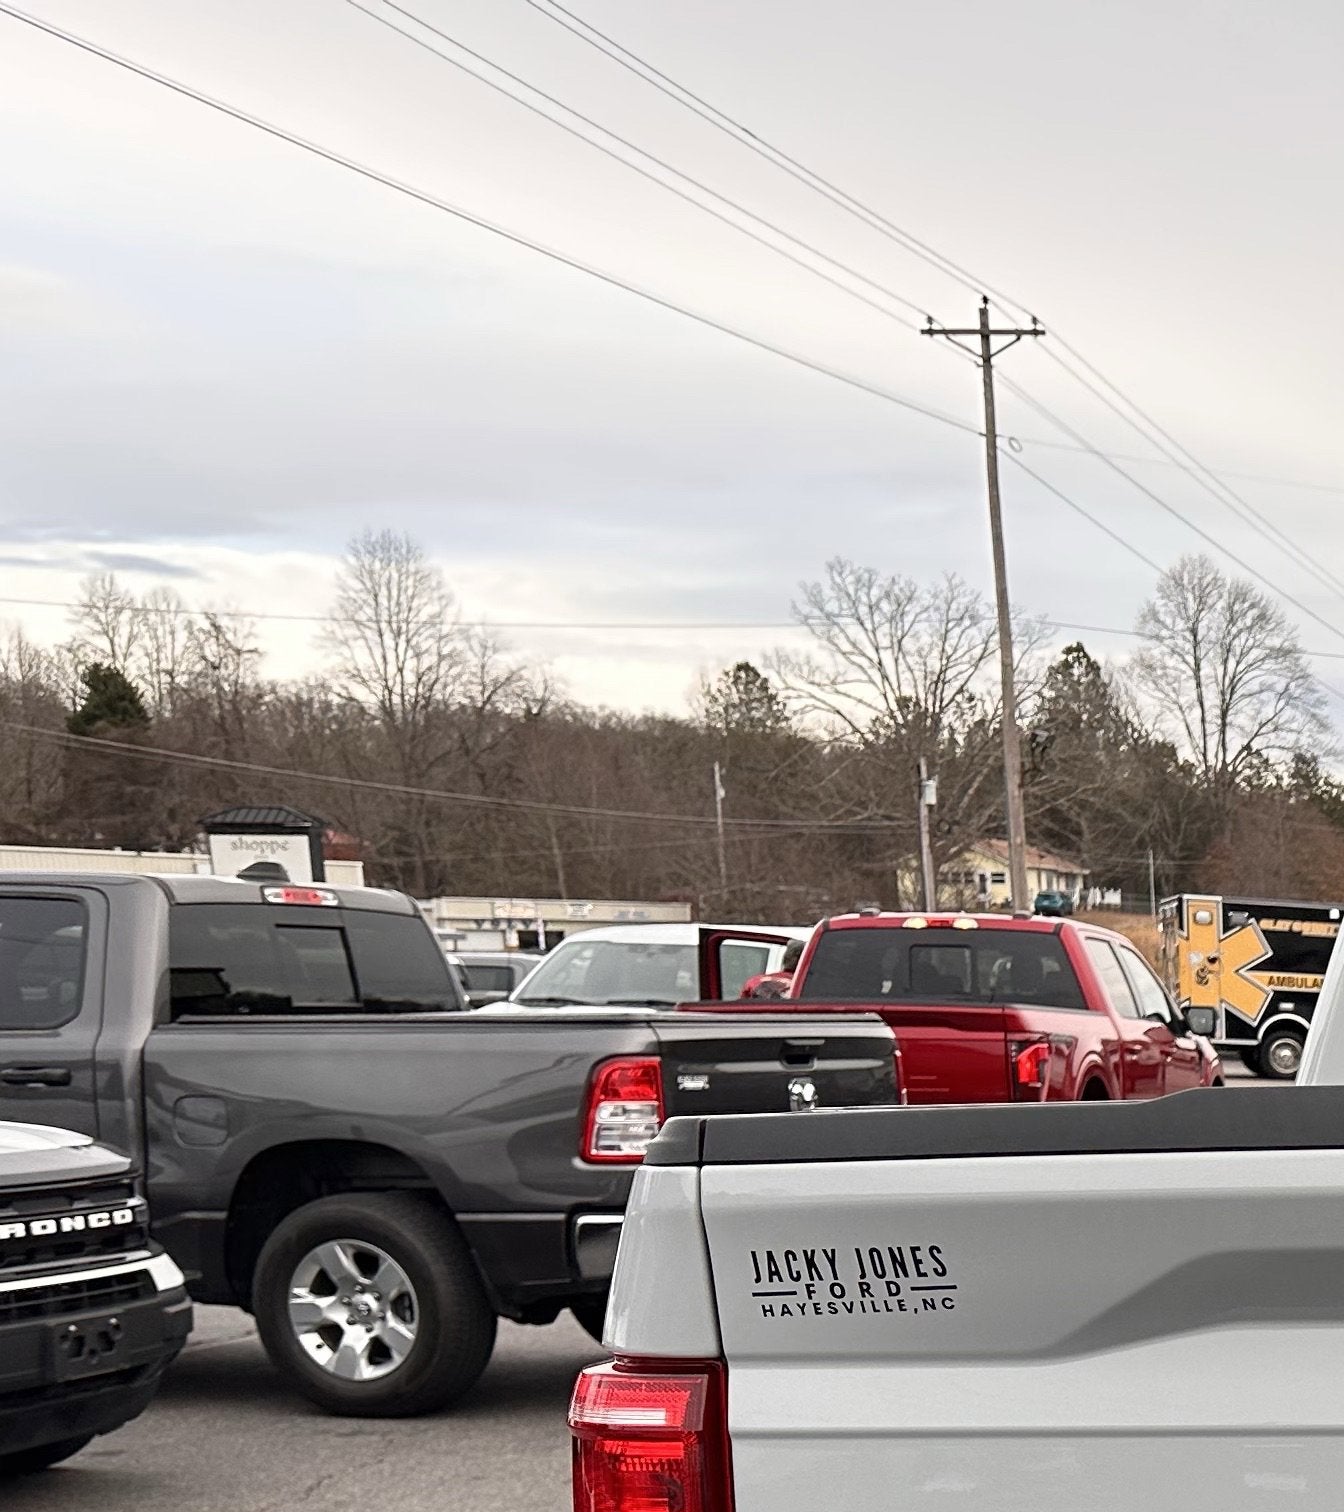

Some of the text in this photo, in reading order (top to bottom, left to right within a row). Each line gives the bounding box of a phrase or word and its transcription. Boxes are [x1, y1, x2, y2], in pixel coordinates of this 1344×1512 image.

[231, 837, 289, 854] shoppe
[1267, 975, 1325, 989] AMBULA
[0, 1208, 134, 1240] RONCO
[750, 1244, 948, 1284] JACKY JONES
[804, 1279, 901, 1300] FORD
